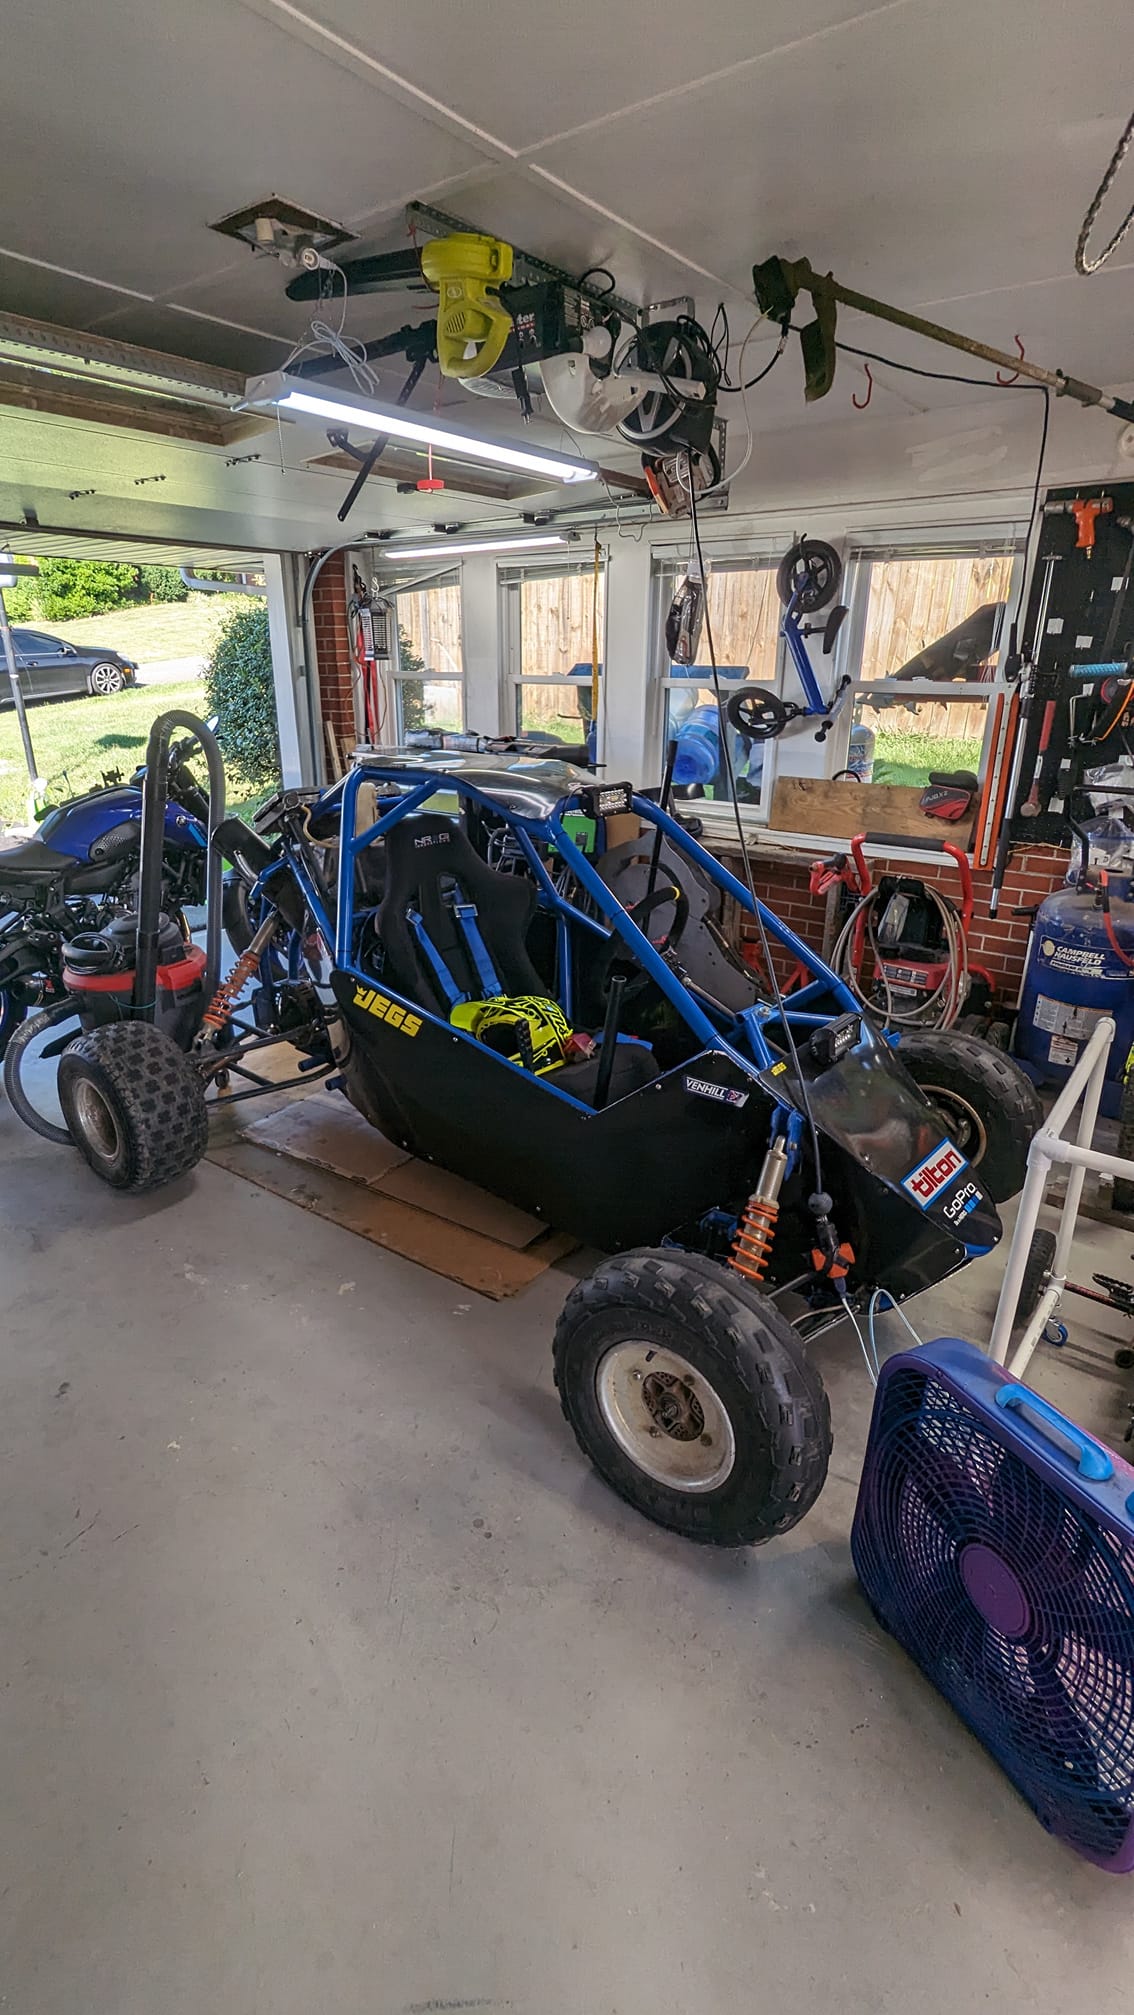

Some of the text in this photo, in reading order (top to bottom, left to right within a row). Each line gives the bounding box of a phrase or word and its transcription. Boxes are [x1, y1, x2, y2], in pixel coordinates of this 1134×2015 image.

[1053, 951, 1102, 965] HAUSFELD
[1056, 945, 1105, 960] CAMPBELL
[353, 989, 424, 1037] JEGS
[686, 1078, 725, 1098] VENHILL
[911, 1150, 961, 1197] tilton
[943, 1182, 977, 1219] GoPro
